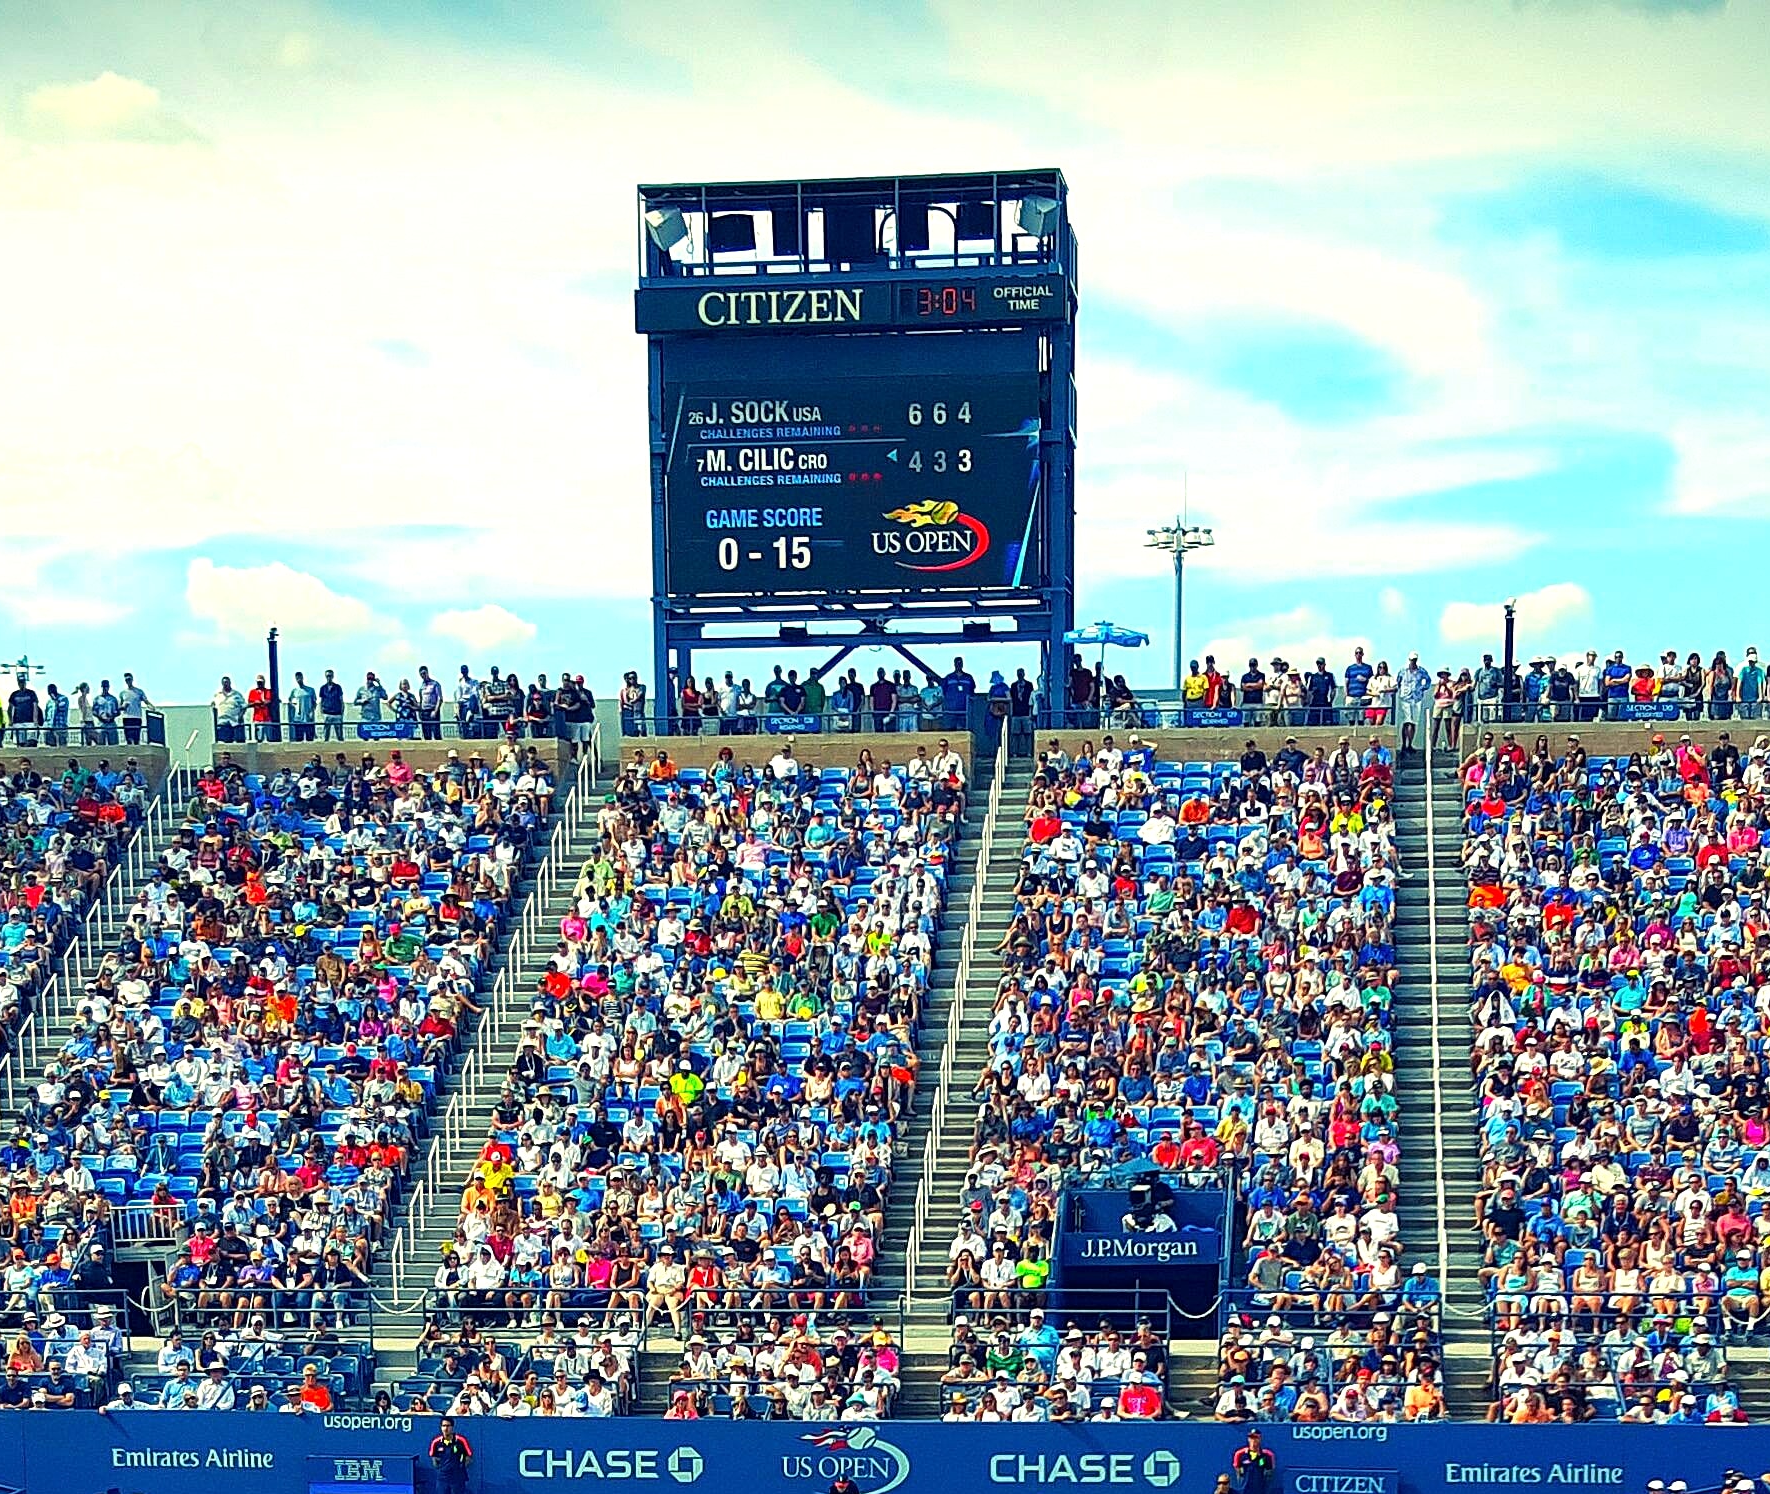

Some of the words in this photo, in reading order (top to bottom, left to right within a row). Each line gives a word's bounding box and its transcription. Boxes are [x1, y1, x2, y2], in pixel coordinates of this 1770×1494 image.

[919, 288, 976, 316] 3:04
[993, 286, 1053, 299] OFFICIAL
[697, 289, 864, 326] CITIZEN
[1007, 299, 1040, 311] TIME
[688, 412, 703, 425] 26
[706, 404, 724, 424] J.
[731, 400, 789, 423] SOCK
[793, 406, 821, 422] USA
[908, 403, 922, 425] 6
[933, 402, 947, 424] 6
[958, 401, 971, 423] 4
[700, 427, 773, 440] CHALLENGES
[777, 425, 841, 437] REMAINING
[697, 460, 703, 472] 7
[706, 449, 732, 472] M.
[739, 447, 794, 471] CILIC
[798, 454, 827, 469] CRO
[908, 450, 922, 473] 4
[934, 451, 947, 472] 3
[958, 449, 972, 472] 3
[701, 474, 774, 487] CHALLENGES
[777, 473, 842, 485] REMAINING
[706, 509, 757, 529] GAME
[762, 507, 823, 527] SCORE
[871, 531, 901, 554] US
[905, 529, 972, 553] OPEN
[718, 538, 739, 570] 0
[772, 536, 811, 569] 15
[1081, 1239, 1197, 1262] J.P.Morgan
[324, 1415, 412, 1431] usopen.org
[1292, 1426, 1387, 1441] usopen.org
[111, 1448, 200, 1468] Emirates
[205, 1448, 274, 1469] Airline
[519, 1449, 659, 1480] CHASE
[782, 1456, 812, 1479] US
[817, 1456, 890, 1479] OPEN
[990, 1454, 1135, 1483] CHASE
[334, 1460, 385, 1481] IBM
[1446, 1463, 1541, 1484] Emirates
[1547, 1463, 1623, 1484] Airline
[1295, 1475, 1386, 1493] CITIZEN
